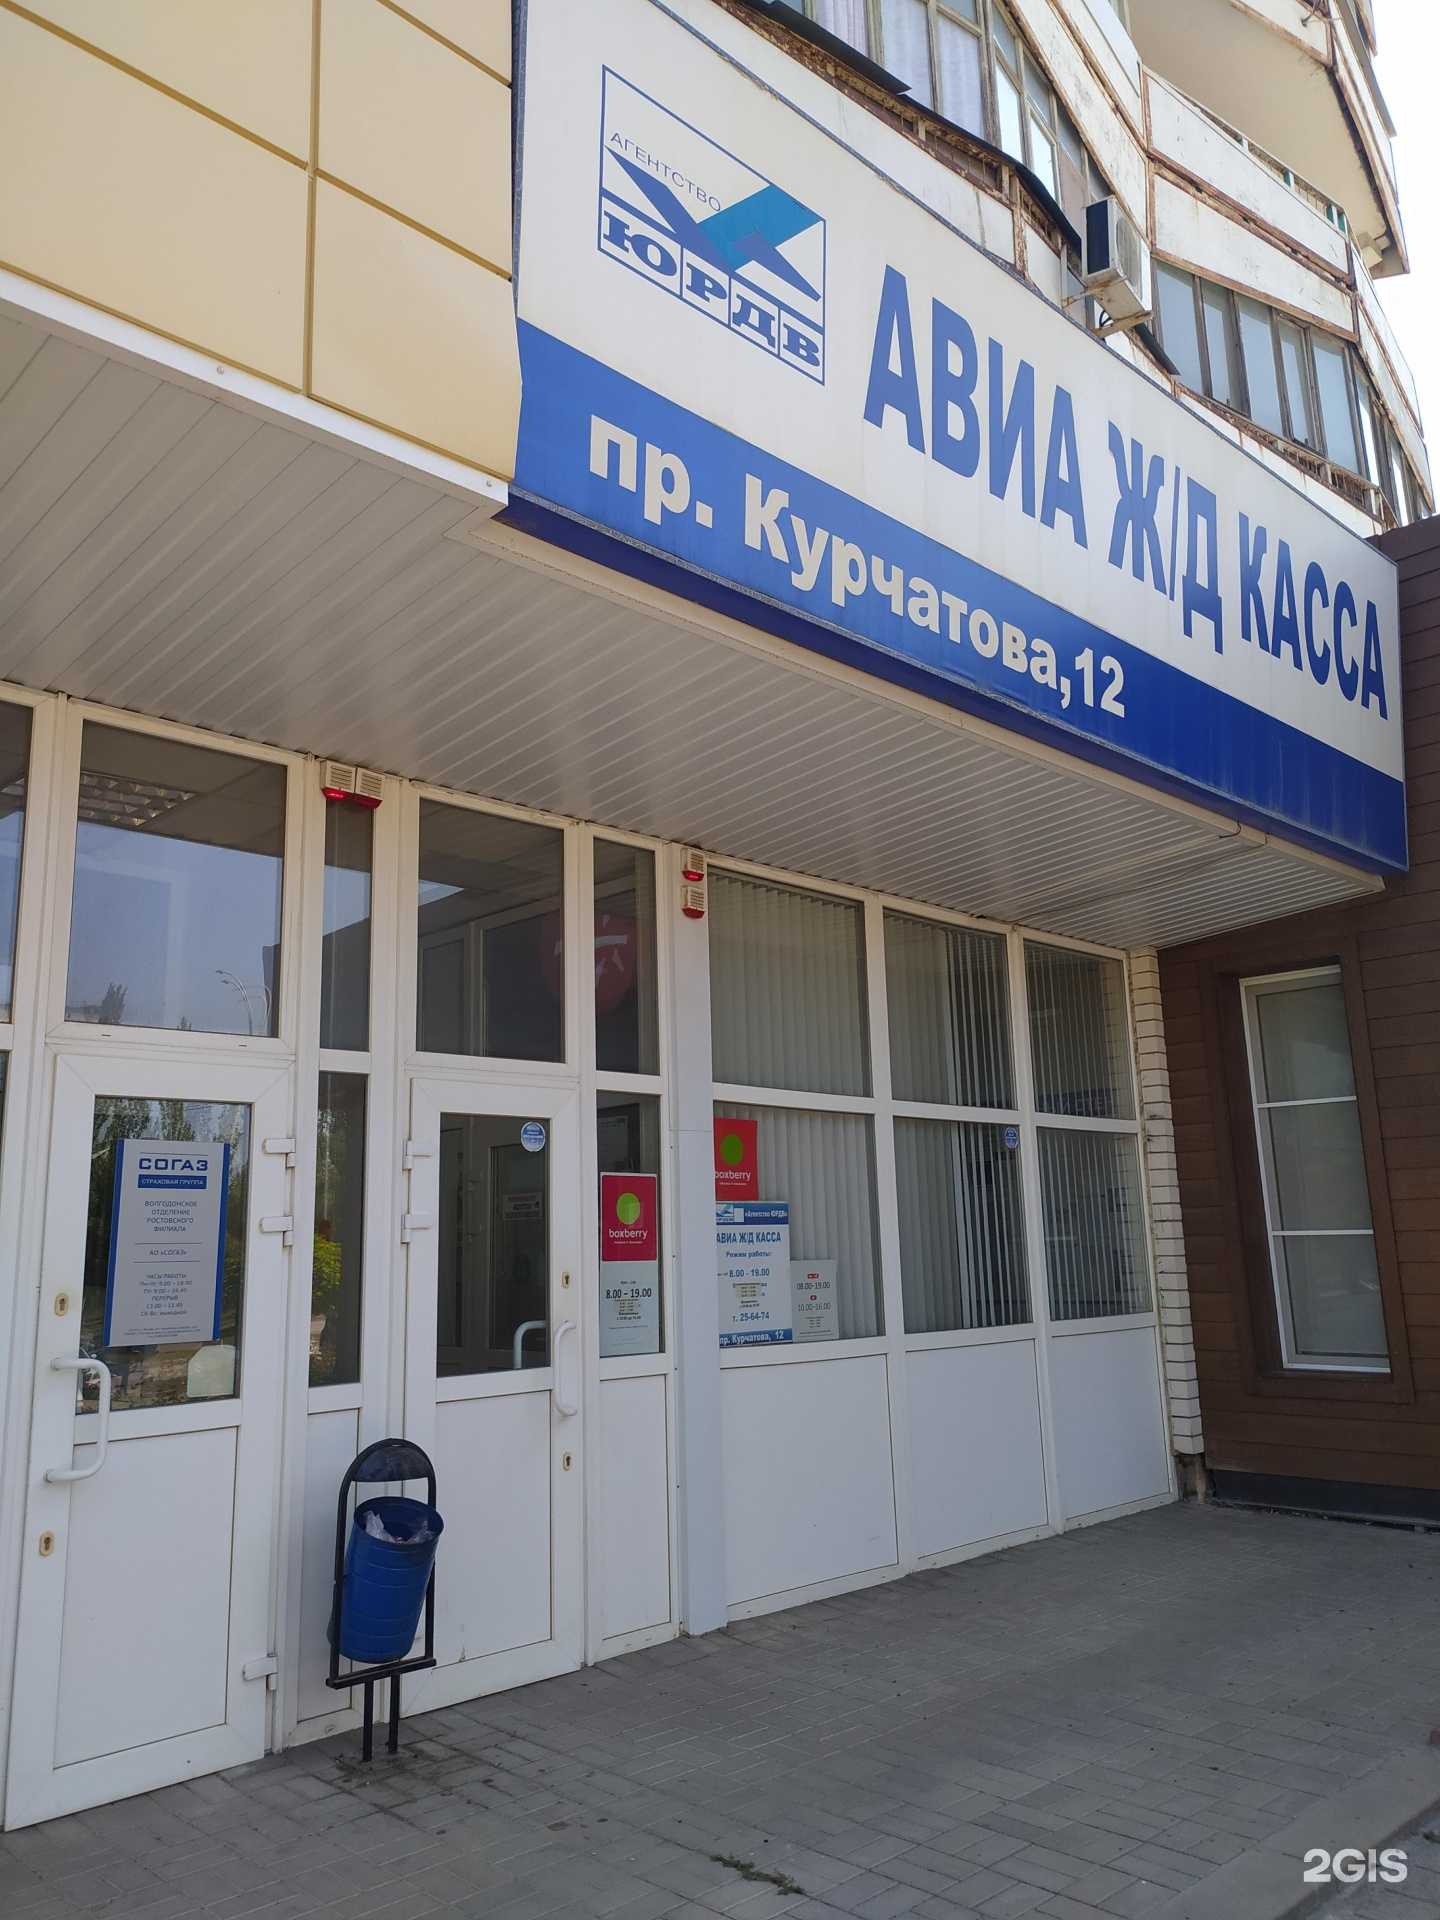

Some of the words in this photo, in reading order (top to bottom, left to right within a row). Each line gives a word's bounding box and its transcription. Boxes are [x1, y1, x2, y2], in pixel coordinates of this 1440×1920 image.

[610, 132, 722, 212] АГЕНТСТВО
[603, 210, 821, 368] ЮРДВ
[589, 413, 713, 526] пр.
[863, 264, 1088, 550] АВИА
[1108, 420, 1224, 655] Ж/Д
[1238, 511, 1389, 721] КАССА
[138, 1158, 209, 1172] СОГАЗ
[144, 1200, 198, 1208] ВОЛГОДОНСКОЕ
[608, 1227, 649, 1240] boxberry
[716, 1232, 737, 1244] АВИА
[755, 1230, 782, 1242] КАССА
[606, 1289, 622, 1299] 8.00
[630, 1287, 652, 1298] 19.00
[775, 1328, 785, 1340] 12
